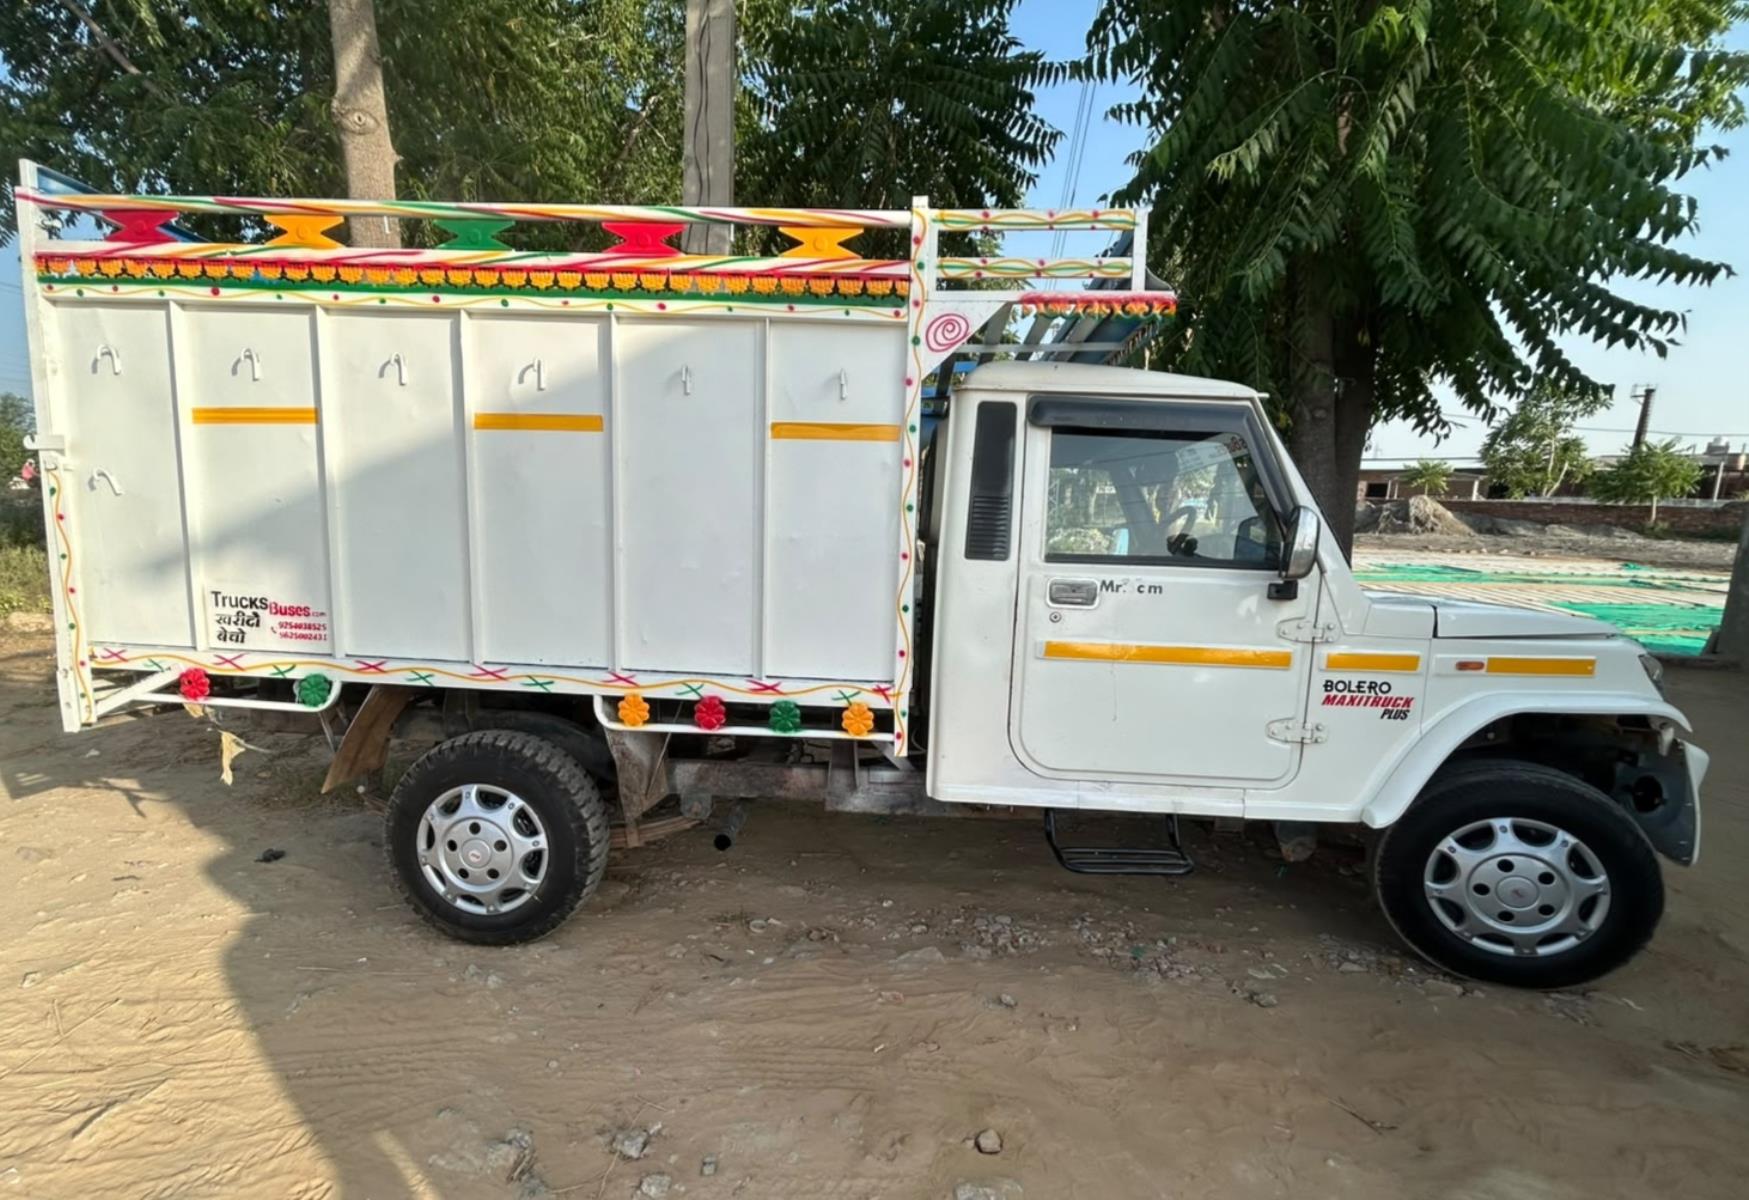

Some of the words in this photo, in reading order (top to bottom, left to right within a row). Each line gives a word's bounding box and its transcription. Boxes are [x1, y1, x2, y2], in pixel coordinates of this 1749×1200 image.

[1323, 679, 1392, 696] BOLERO
[1321, 694, 1415, 709] MAXITRUCK
[1380, 708, 1410, 720] PLUS
